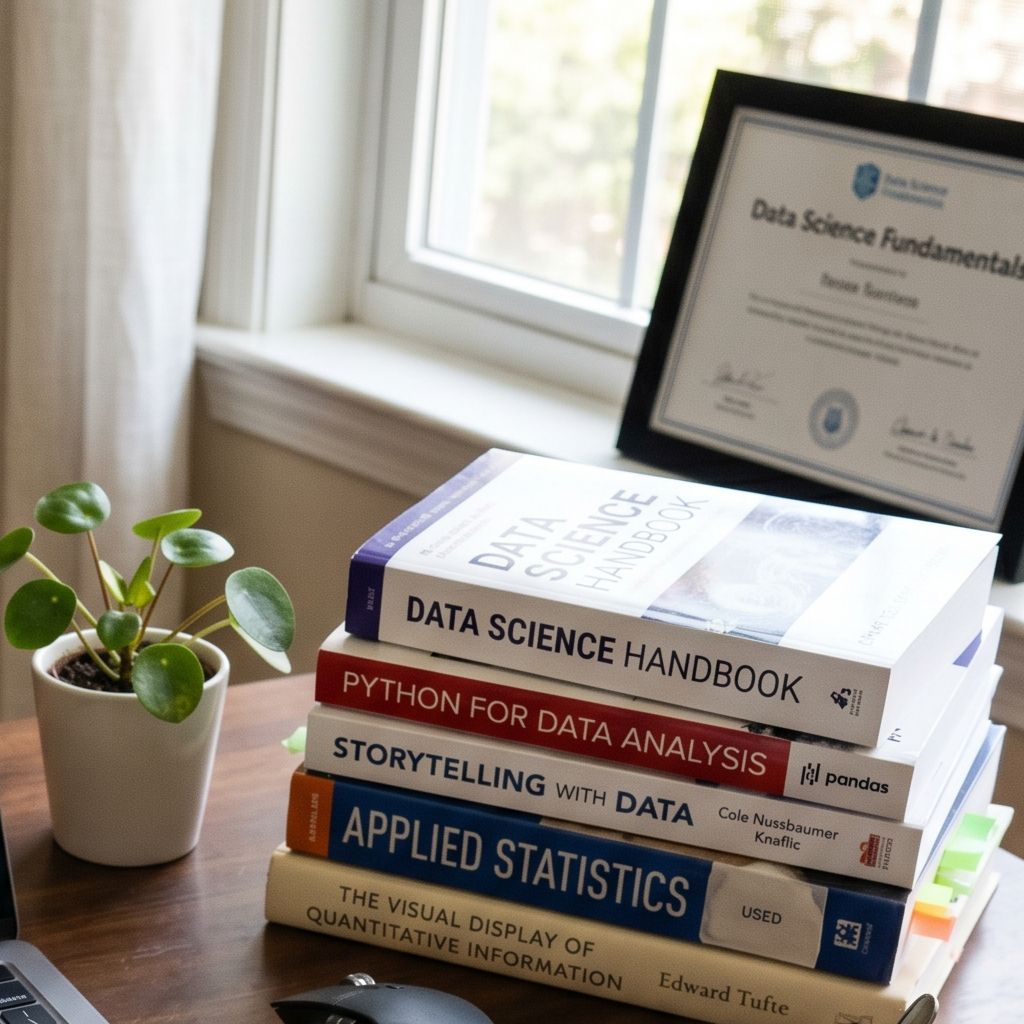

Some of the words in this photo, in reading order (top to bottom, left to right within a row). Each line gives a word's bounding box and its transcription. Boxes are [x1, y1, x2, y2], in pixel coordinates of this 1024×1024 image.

[751, 197, 797, 228] Data
[801, 208, 878, 246] Science
[468, 515, 567, 573] DATA
[524, 489, 659, 582] SCIENCE
[575, 494, 710, 592] HANDBOOK
[407, 595, 480, 637] DATA
[488, 612, 617, 664] SCIENCE
[623, 640, 803, 704] HANDBOOK
[342, 670, 461, 717] PYTHON
[469, 696, 529, 729] FOR
[537, 709, 613, 747] DATA
[620, 725, 767, 777] ANALYSIS
[332, 737, 547, 798] STORYTELLING
[555, 782, 608, 807] WITH
[615, 790, 694, 827] DATA
[824, 770, 890, 797] pandas
[718, 806, 749, 826] Cole
[752, 811, 839, 841] Nussbaumer
[754, 829, 801, 851] Knaflic
[342, 806, 482, 872] APPLIED
[494, 840, 690, 918] STATISTICS
[306, 906, 460, 958] QUANTITATIVE
[466, 940, 624, 992] INFORMATION
[339, 885, 380, 908] THE
[387, 894, 463, 926] VISUAL
[468, 914, 557, 950] DISPLAY
[564, 936, 595, 958] OF
[741, 904, 783, 926] USED
[658, 972, 731, 1004] Edward
[737, 988, 790, 1017] Tufte
